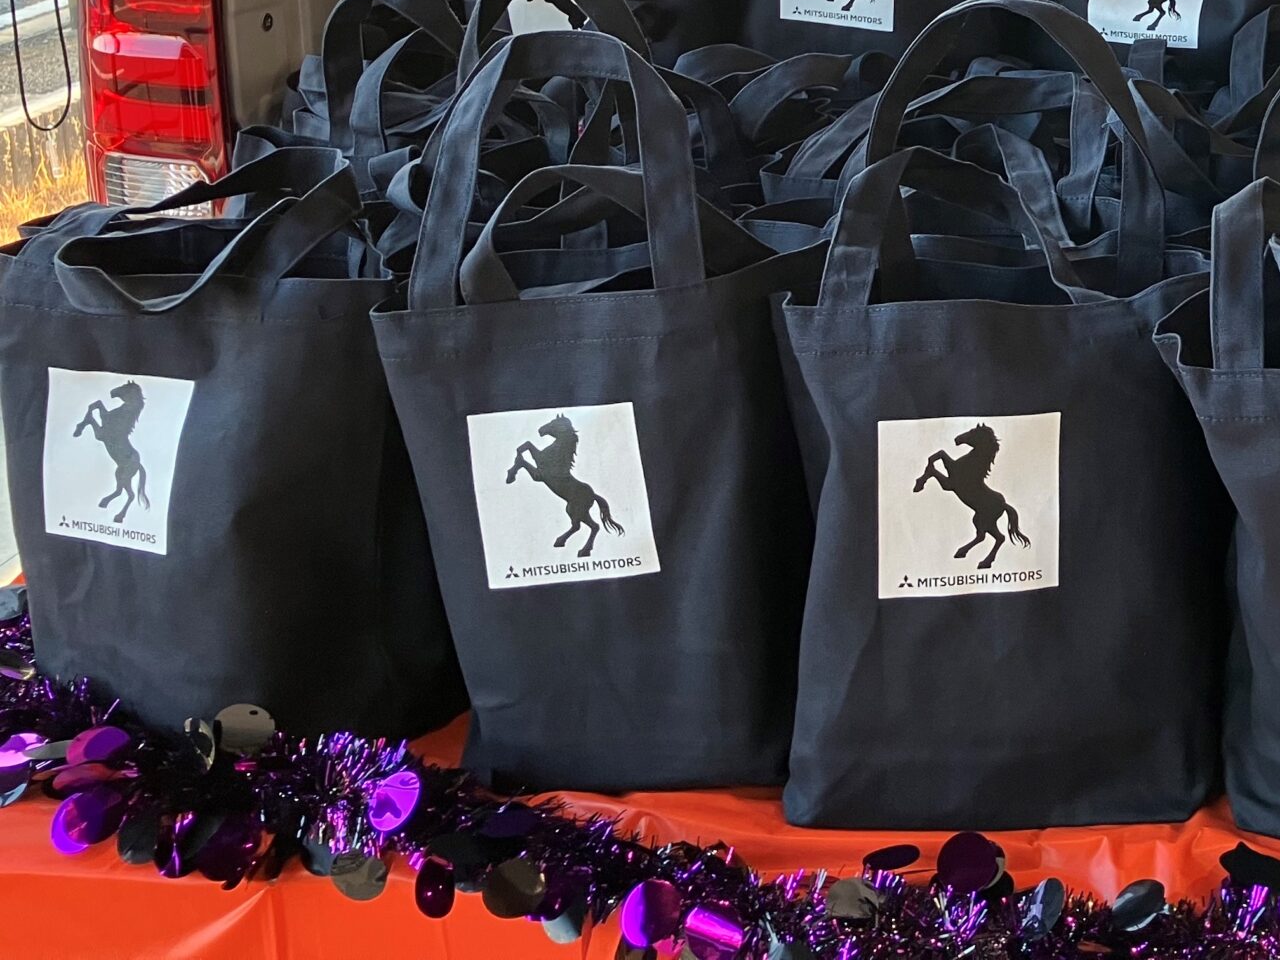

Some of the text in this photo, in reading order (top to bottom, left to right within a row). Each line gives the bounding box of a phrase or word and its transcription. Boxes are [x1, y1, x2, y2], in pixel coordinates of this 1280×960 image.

[804, 9, 883, 25] MITSUBISHI MOTORS
[71, 520, 157, 544] MITSUBISHI MOTORS
[522, 556, 642, 578] MITSUBISHI MOTORS
[917, 569, 1043, 588] MITSUBISHI MOTORS
